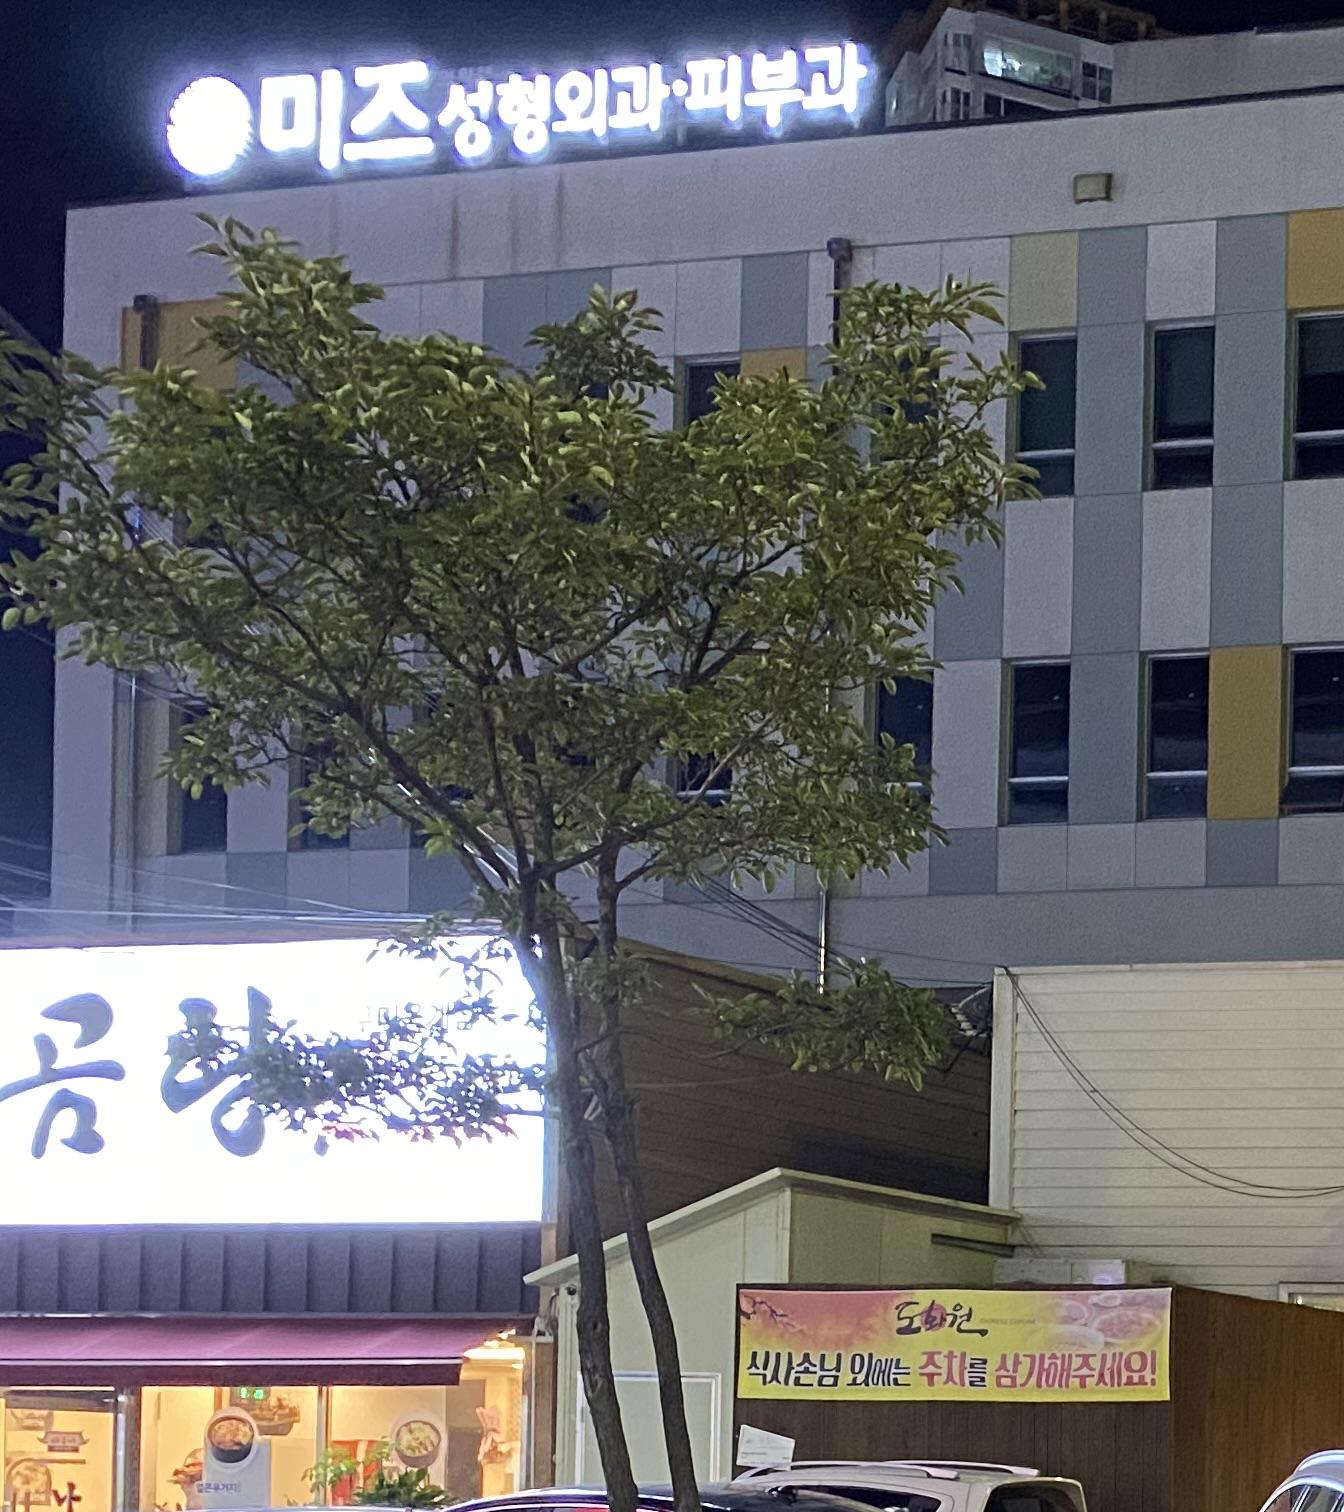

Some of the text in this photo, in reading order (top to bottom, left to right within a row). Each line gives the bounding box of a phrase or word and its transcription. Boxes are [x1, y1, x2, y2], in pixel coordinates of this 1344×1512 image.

[260, 60, 435, 171] 미즈
[894, 1300, 989, 1338] 도화원
[747, 1349, 1158, 1389] 식사손님 외에는 주차를 삼가해주세요!
